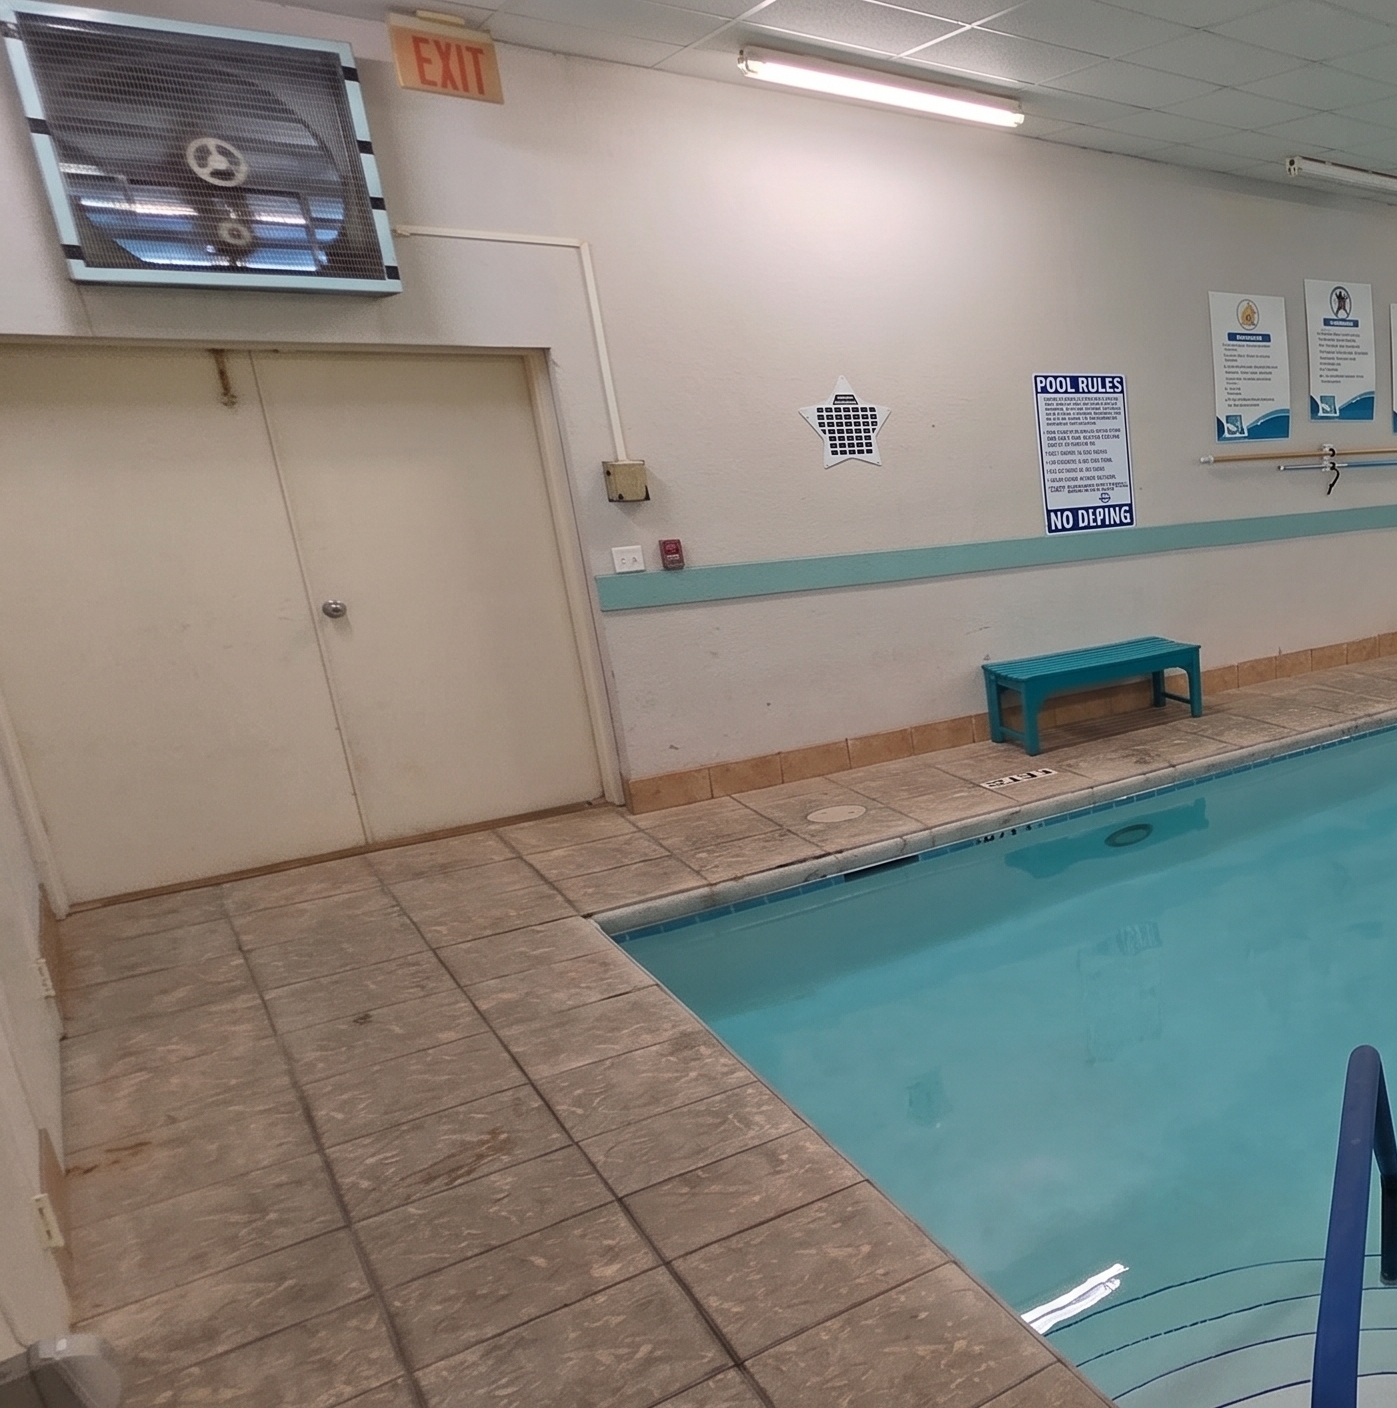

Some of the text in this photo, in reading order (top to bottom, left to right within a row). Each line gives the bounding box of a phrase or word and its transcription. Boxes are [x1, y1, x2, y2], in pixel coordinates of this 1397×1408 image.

[412, 35, 485, 95] EXIT
[1036, 376, 1123, 393] POOL RULES
[1050, 510, 1074, 530] NO
